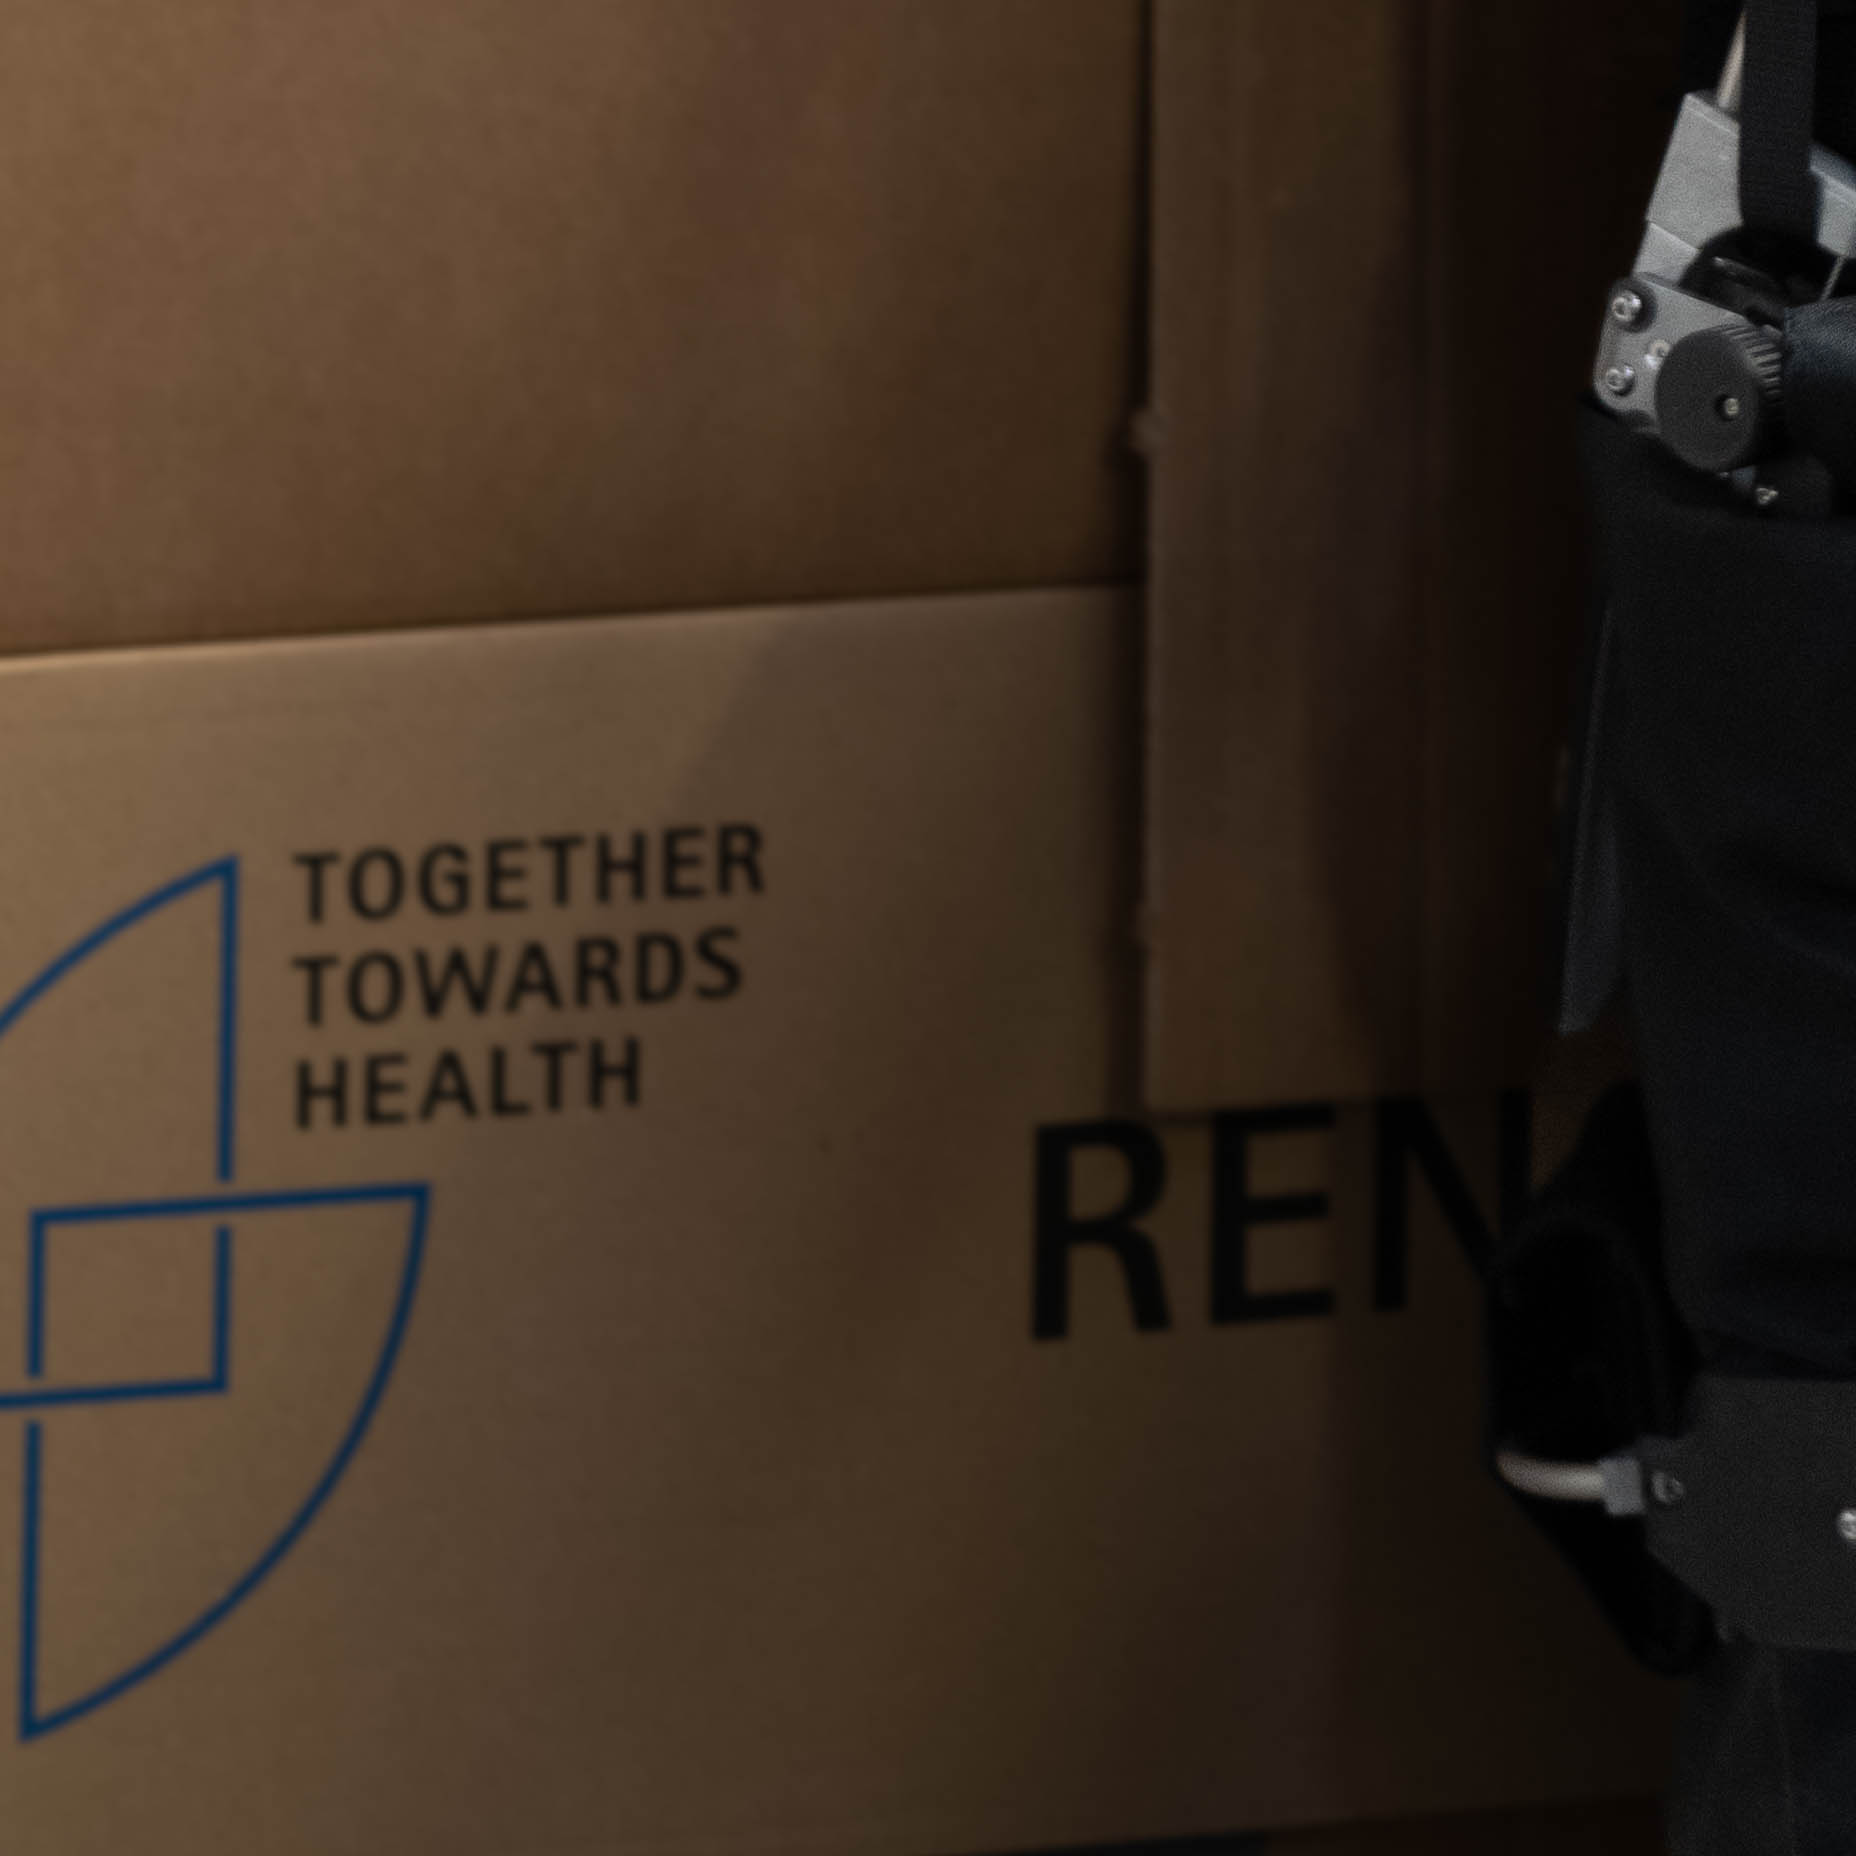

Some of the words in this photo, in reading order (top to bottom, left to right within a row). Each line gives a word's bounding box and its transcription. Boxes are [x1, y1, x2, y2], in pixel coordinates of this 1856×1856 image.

[293, 822, 765, 924] TOGETHER
[292, 926, 743, 1027] TOWARDS
[294, 1036, 642, 1131] HEALTH
